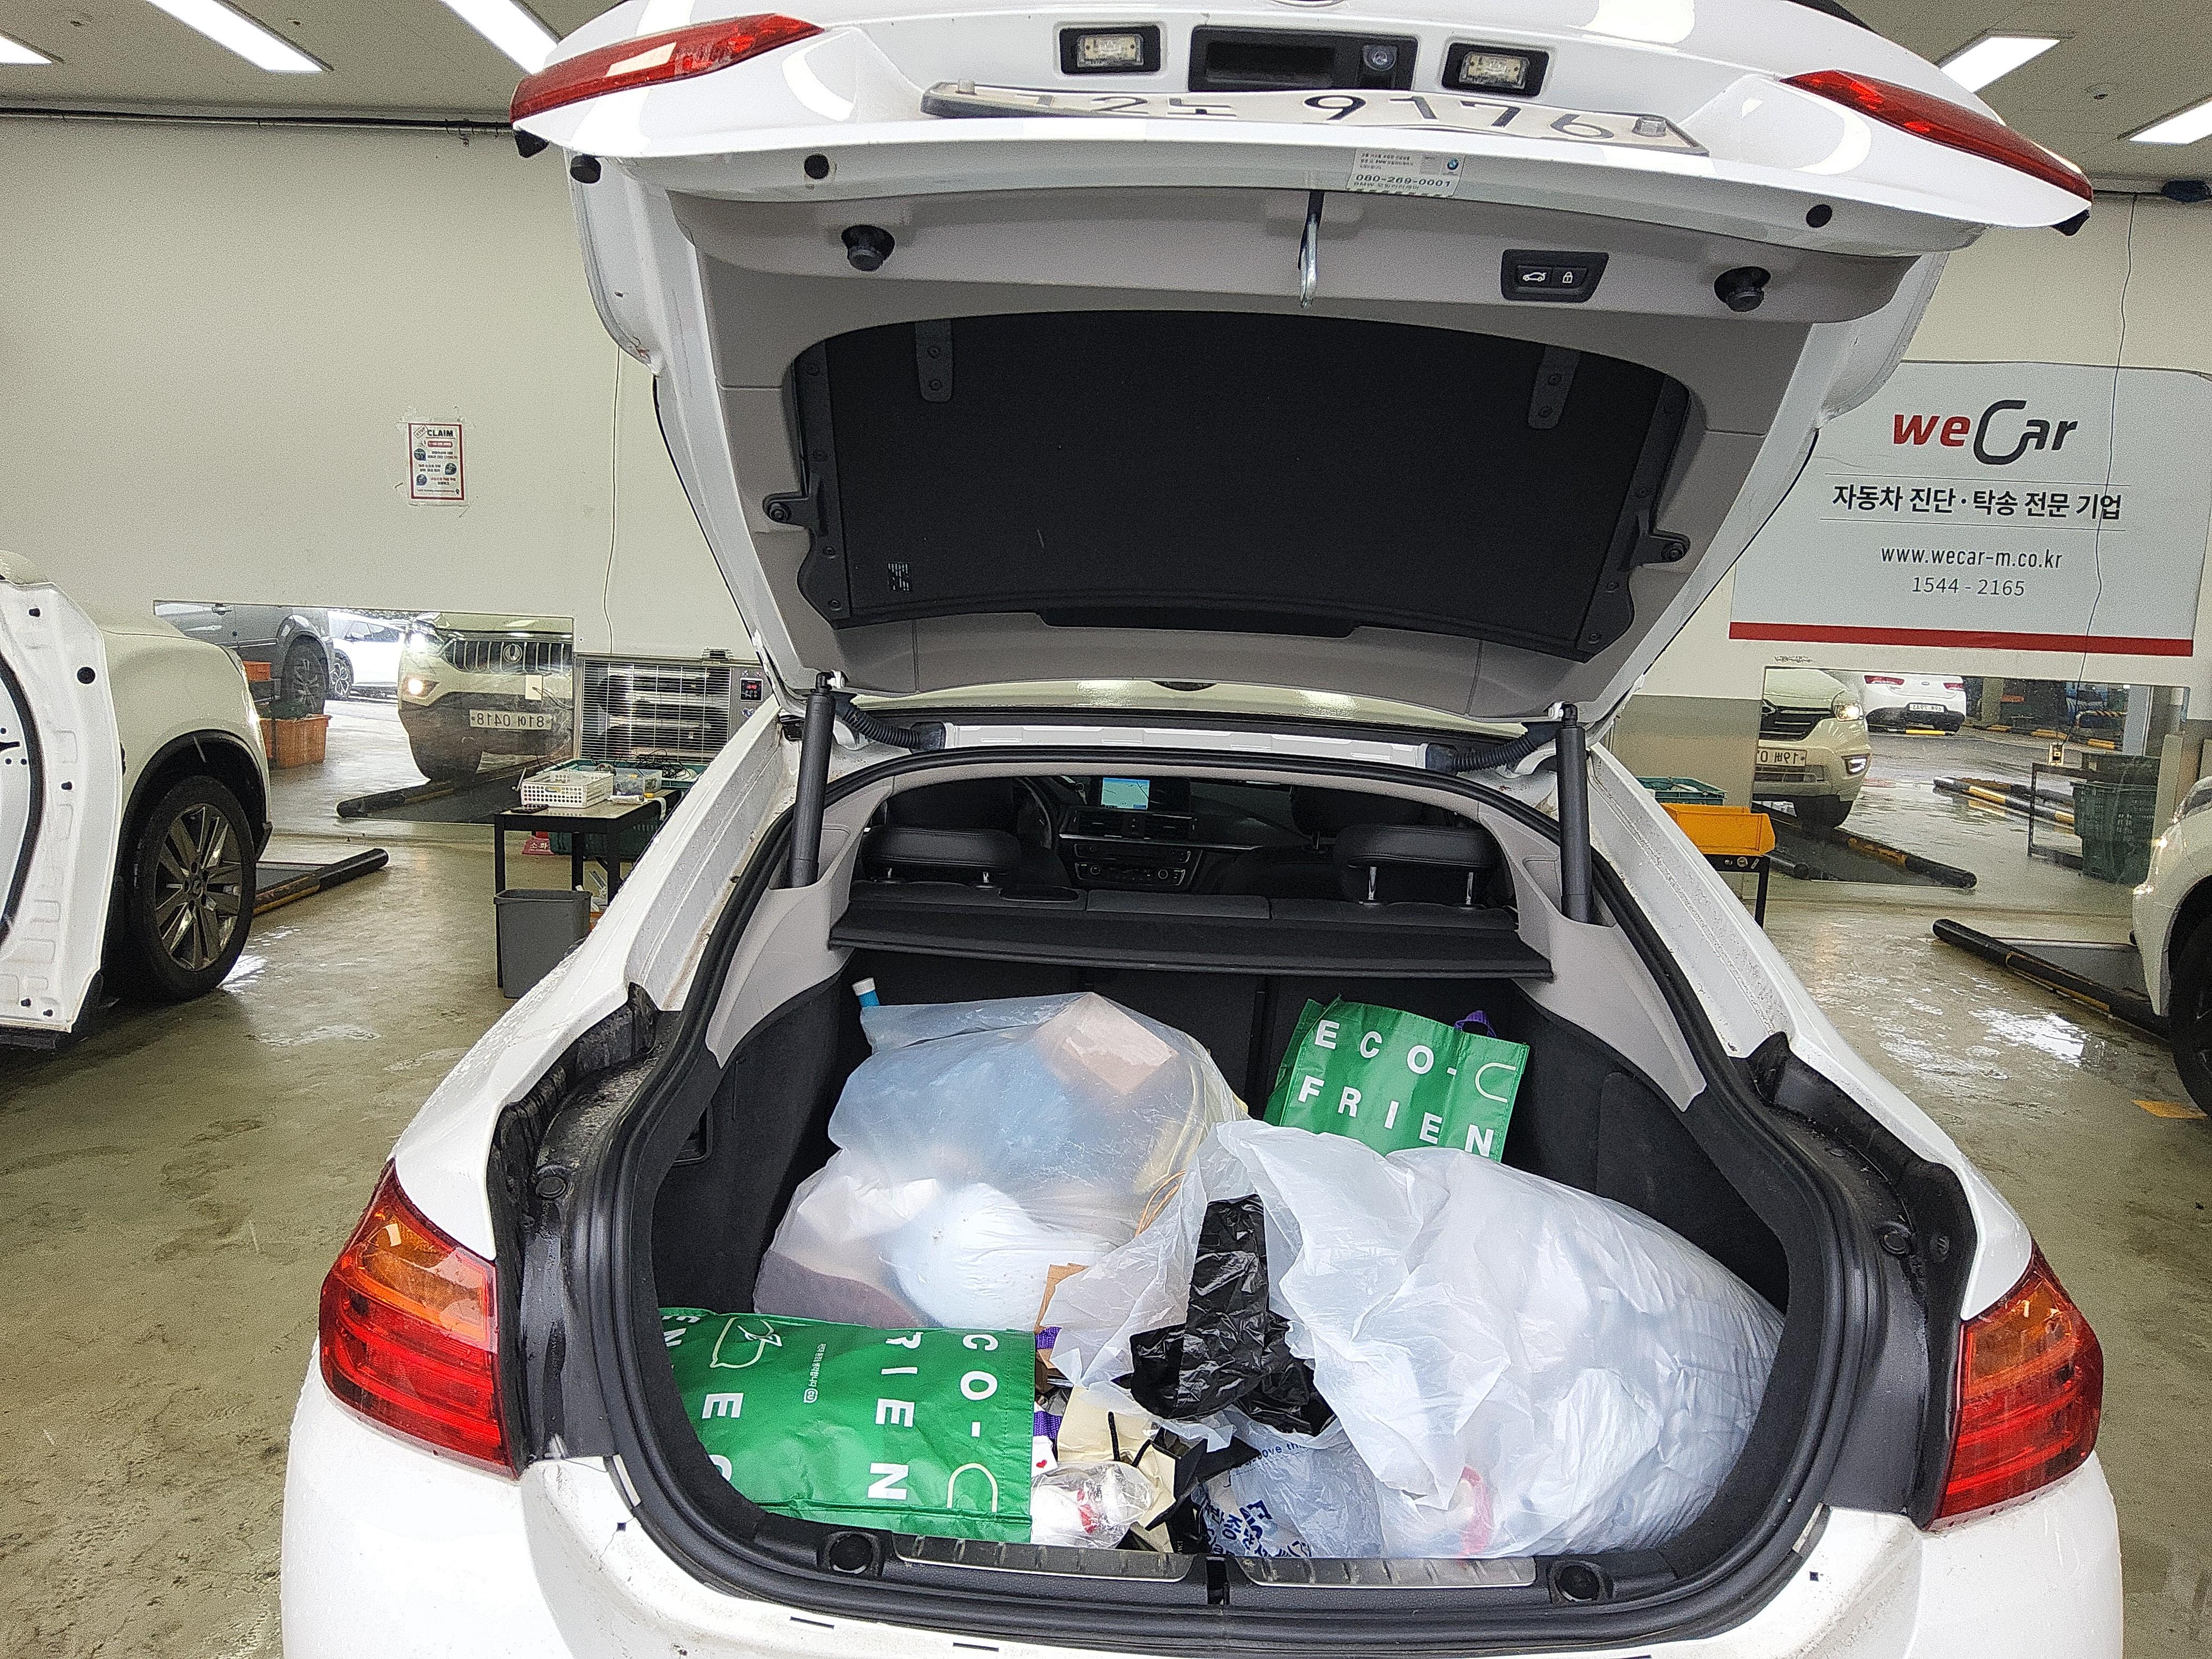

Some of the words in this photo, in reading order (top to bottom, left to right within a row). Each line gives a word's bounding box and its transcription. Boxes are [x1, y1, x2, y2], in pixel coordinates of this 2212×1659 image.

[1304, 94, 1614, 139] 9176
[1833, 484, 1903, 511] 자동차
[2024, 491, 2071, 518] 전문
[2076, 495, 2121, 520] 기업
[1881, 548, 2062, 568] www.wecar-m.co.kr
[1298, 1075, 1494, 1157] FRIEN
